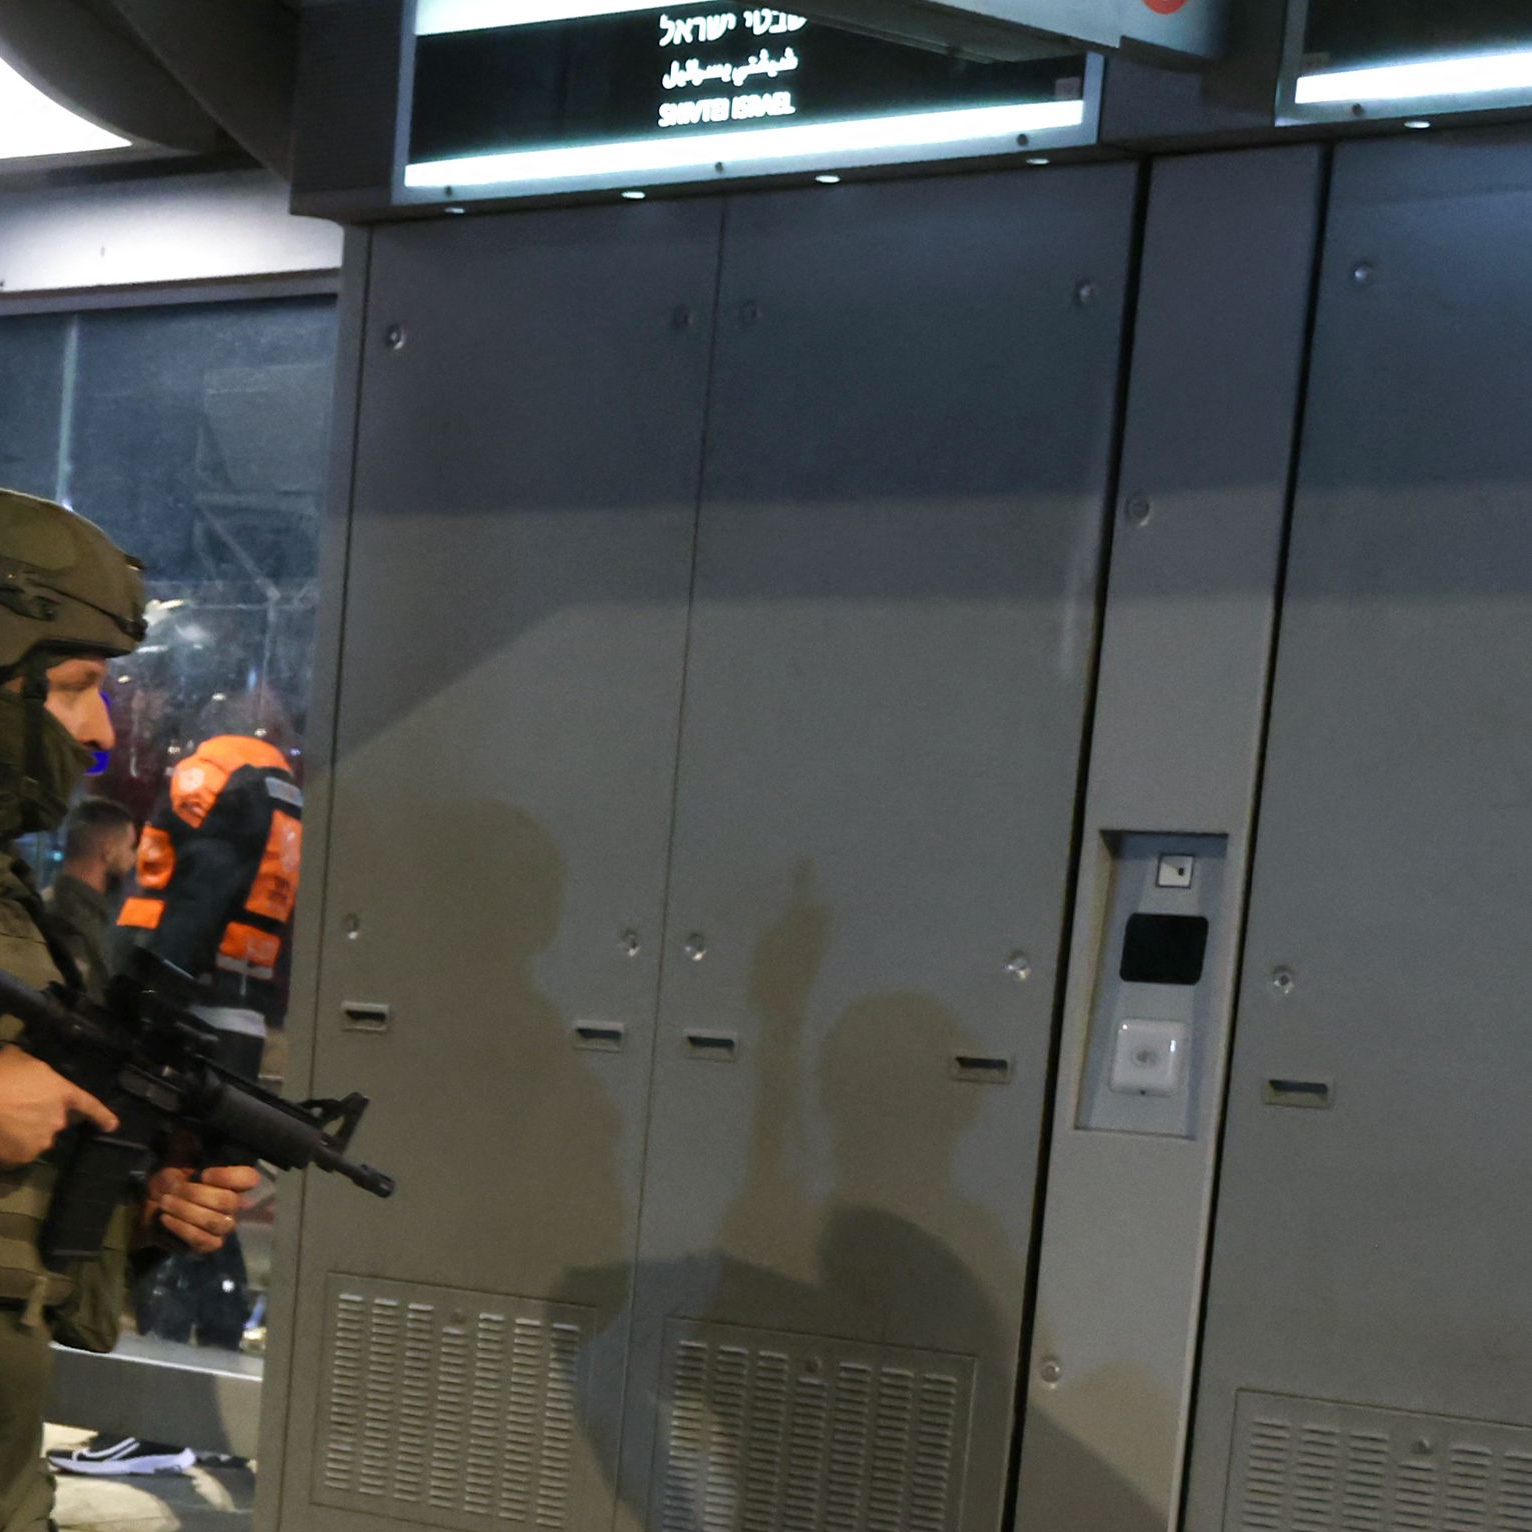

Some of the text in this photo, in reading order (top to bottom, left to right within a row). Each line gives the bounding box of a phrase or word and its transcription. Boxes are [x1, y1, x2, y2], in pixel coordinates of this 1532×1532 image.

[659, 13, 736, 47] ישראל
[658, 91, 796, 128] SHIVTEI ISRAEL
